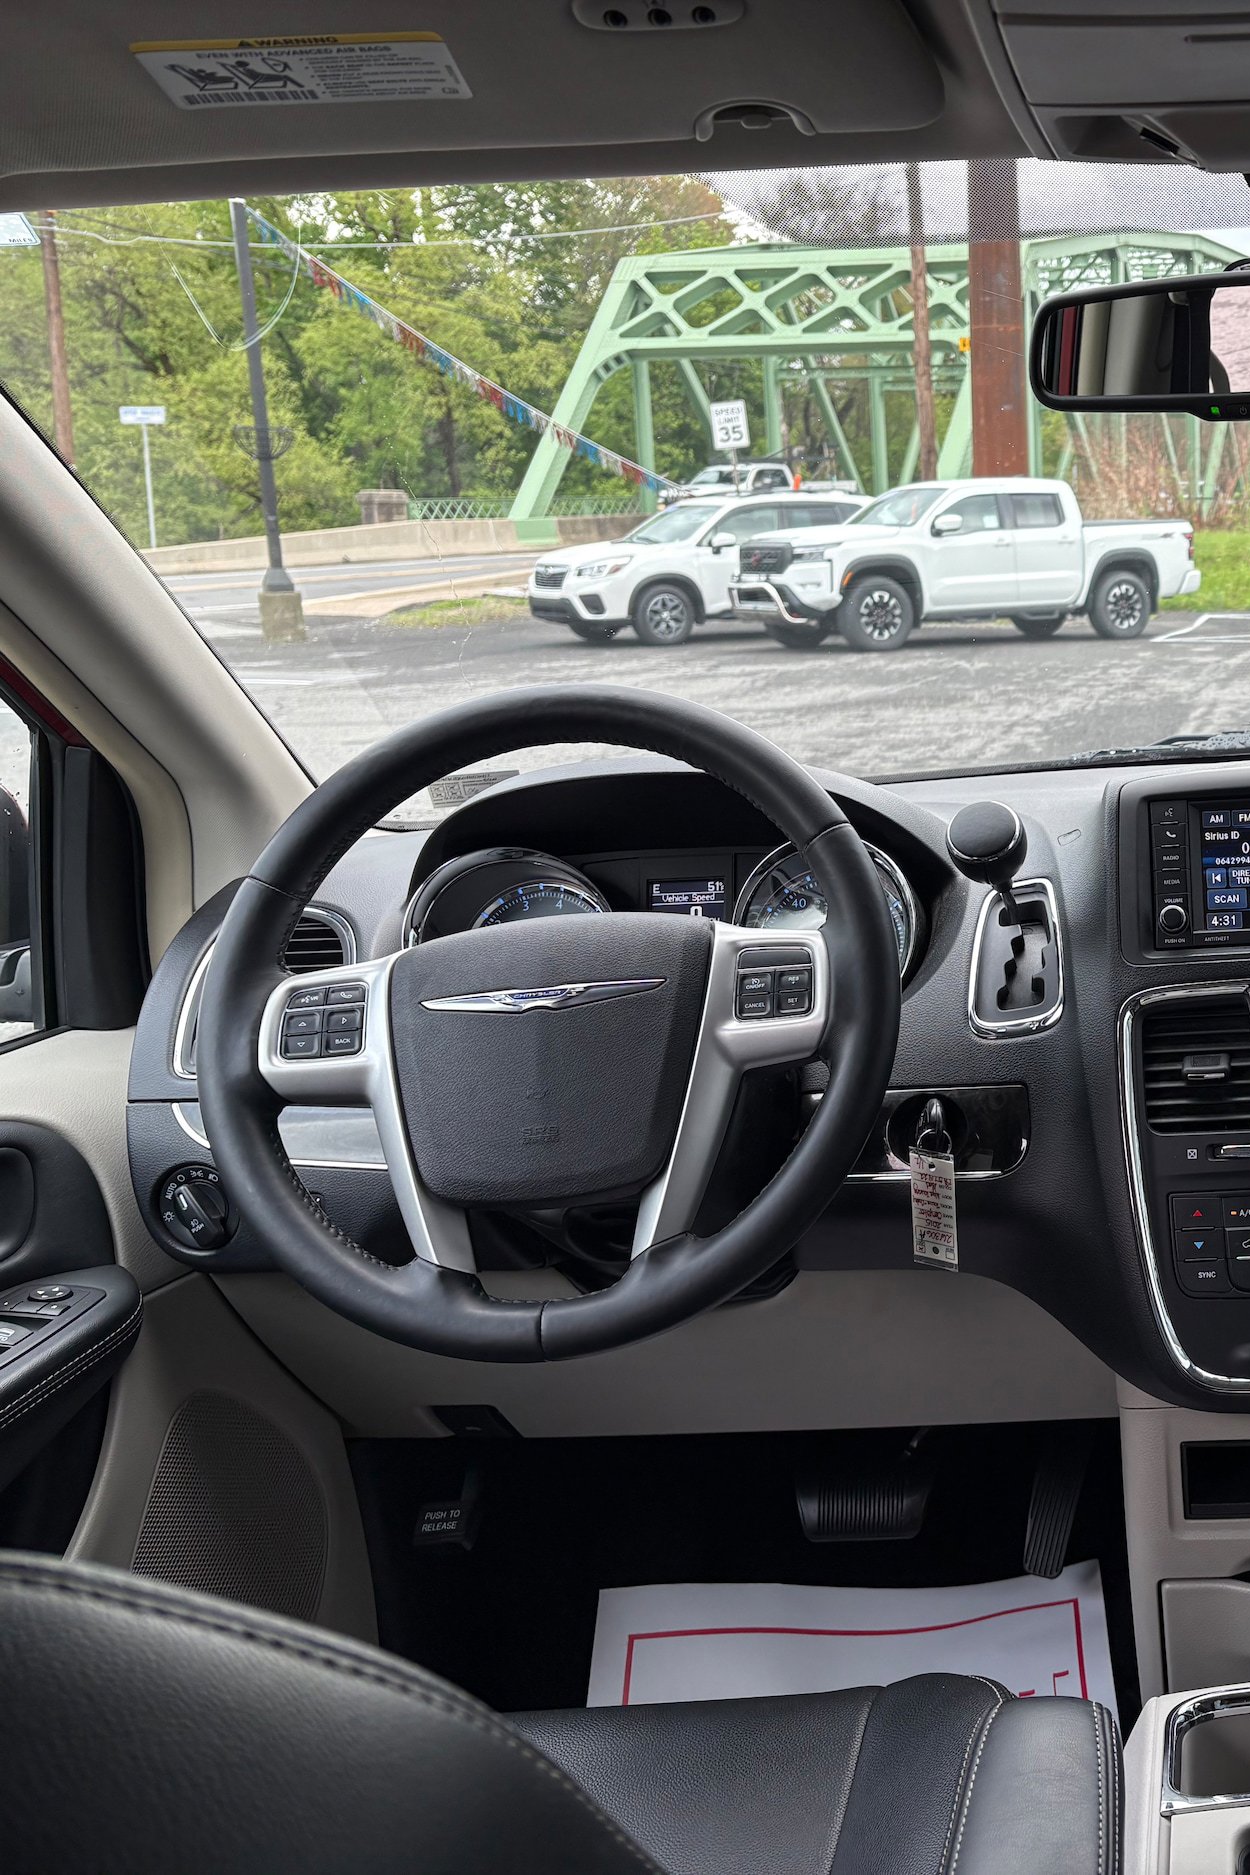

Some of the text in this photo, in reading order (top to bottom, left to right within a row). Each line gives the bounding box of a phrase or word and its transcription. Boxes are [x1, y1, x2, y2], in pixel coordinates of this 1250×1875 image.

[255, 36, 338, 46] WARNING
[267, 48, 333, 56] ADVANCED
[359, 45, 392, 53] BAGS
[712, 406, 743, 416] SPEED
[718, 416, 740, 425] LIMIT
[718, 424, 744, 443] 35
[1209, 814, 1224, 823] AM
[1204, 831, 1240, 841] Sirius ID
[1241, 842, 1250, 854] 0
[652, 883, 661, 894] E
[661, 892, 715, 903] Vehicle Speed
[791, 897, 807, 909] 40
[1214, 894, 1240, 904] SCAN
[522, 900, 530, 911] 3
[555, 898, 563, 910] 4
[1211, 915, 1237, 926] 4:31
[513, 990, 566, 999] CHRYSLER
[165, 1182, 177, 1200] AUTO
[1197, 1271, 1216, 1279] SYNC
[424, 1509, 461, 1520] PUSH TO
[421, 1520, 458, 1532] RELEASE
